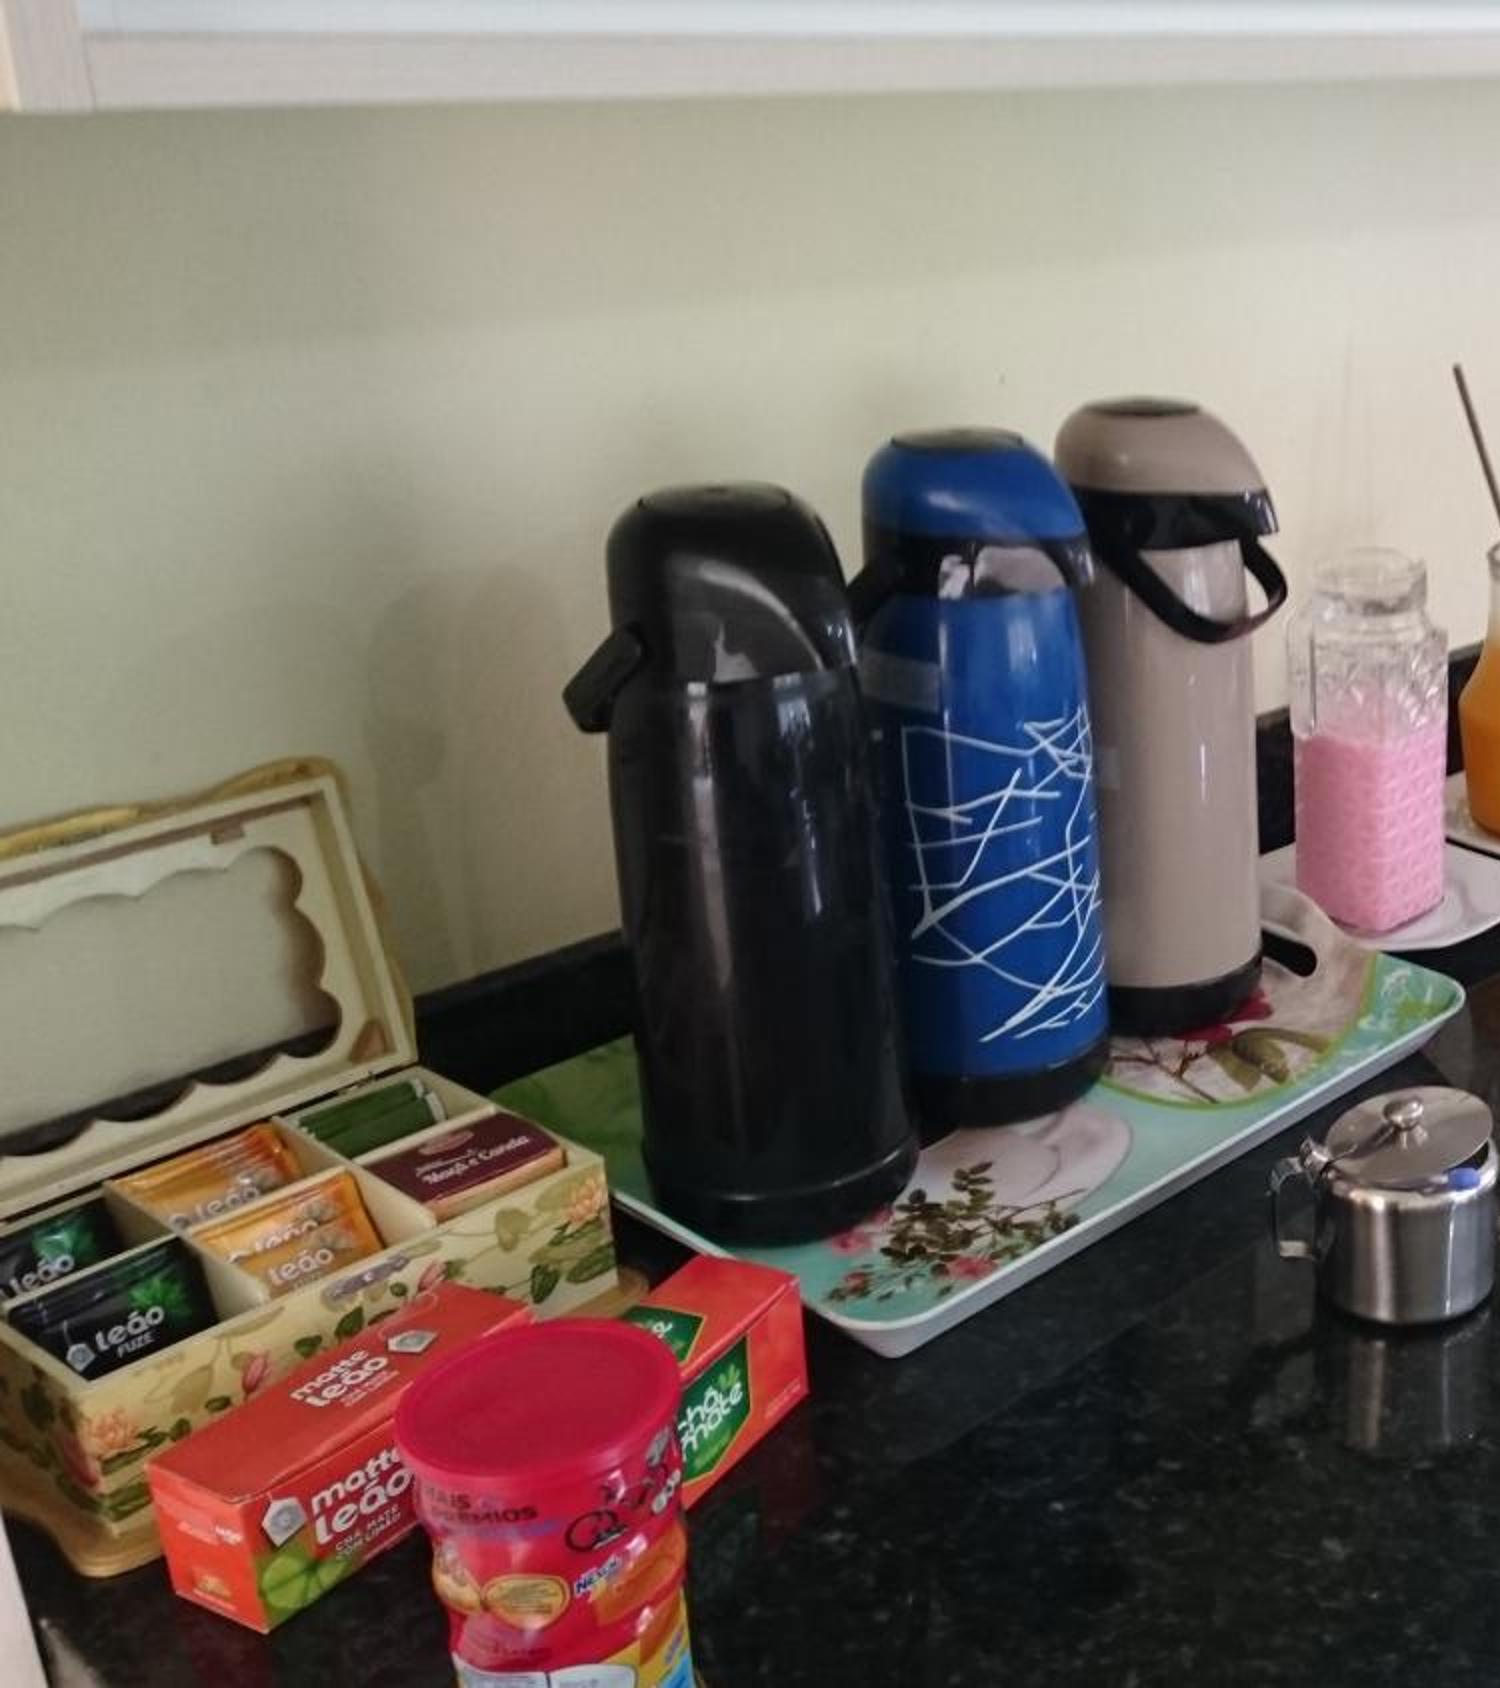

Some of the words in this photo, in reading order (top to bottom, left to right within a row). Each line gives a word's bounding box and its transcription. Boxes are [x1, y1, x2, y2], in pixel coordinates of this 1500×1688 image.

[8, 1253, 75, 1292] leão
[268, 1247, 333, 1286] leão
[95, 1305, 165, 1351] leão
[116, 1331, 156, 1358] FUZE
[290, 1350, 368, 1401] matte
[304, 1356, 388, 1407] leão
[315, 1467, 413, 1545] leão
